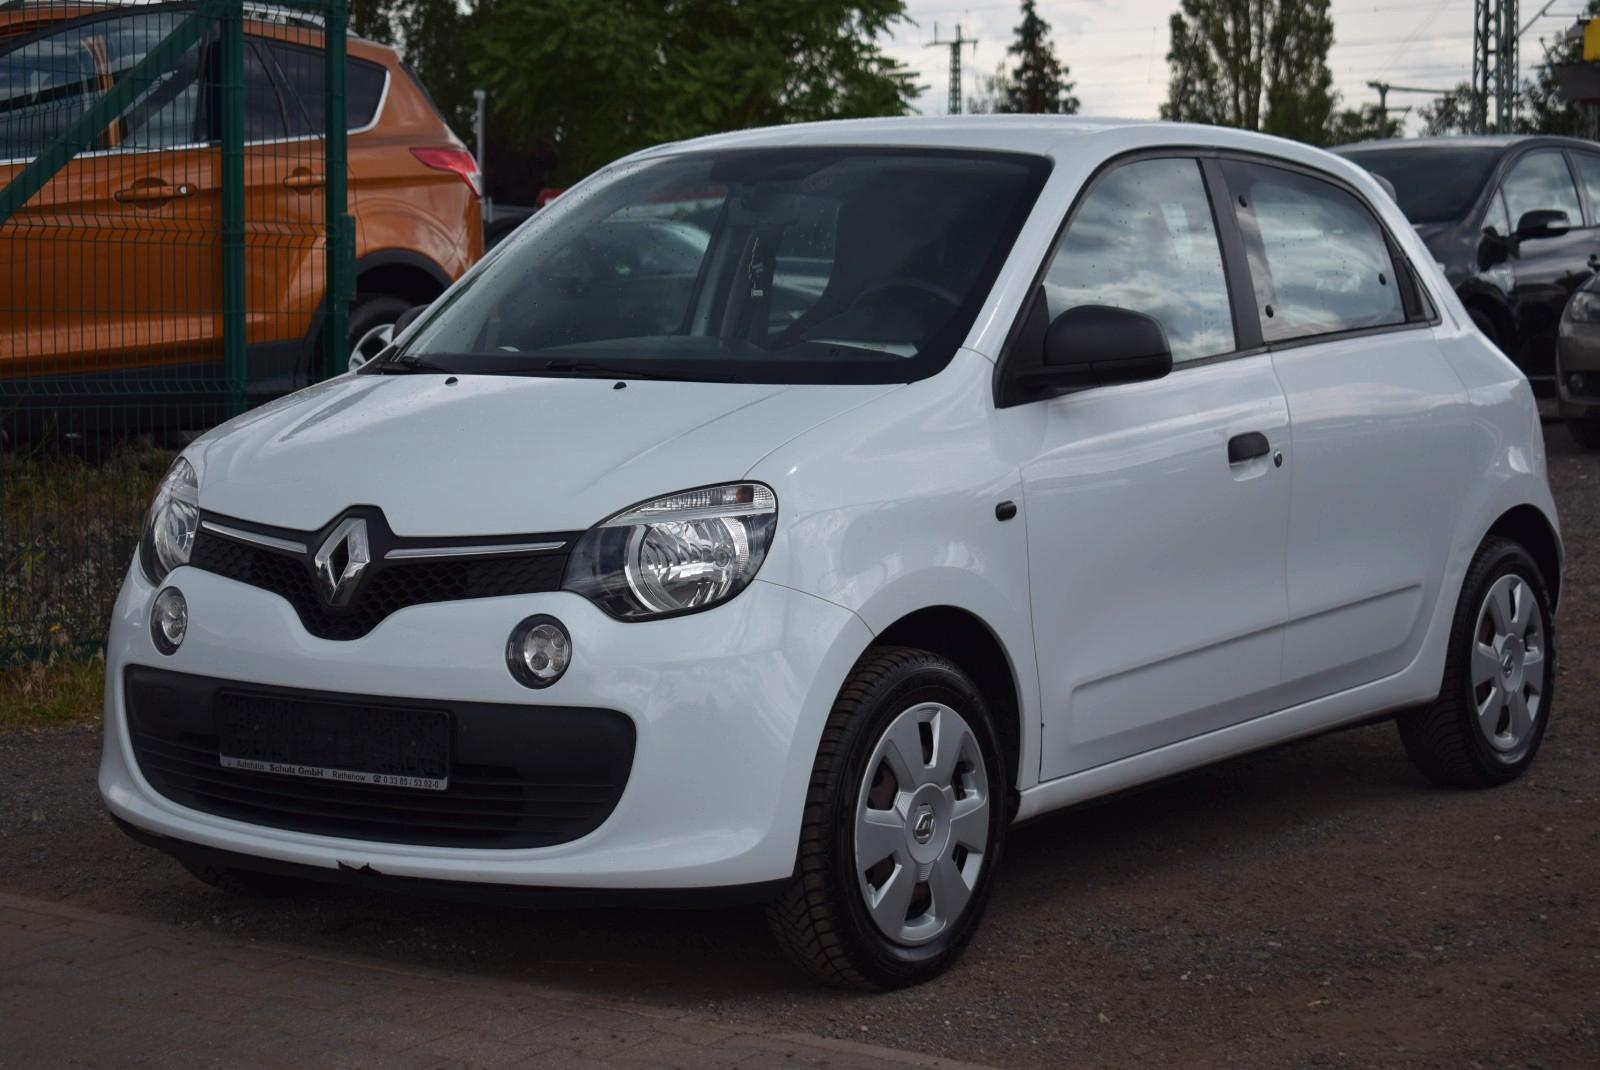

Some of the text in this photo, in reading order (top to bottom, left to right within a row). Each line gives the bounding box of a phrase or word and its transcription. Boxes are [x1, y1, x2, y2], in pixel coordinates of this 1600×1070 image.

[269, 764, 296, 774] Schulz
[298, 766, 323, 776] GmbH
[332, 770, 366, 782] Rathenow
